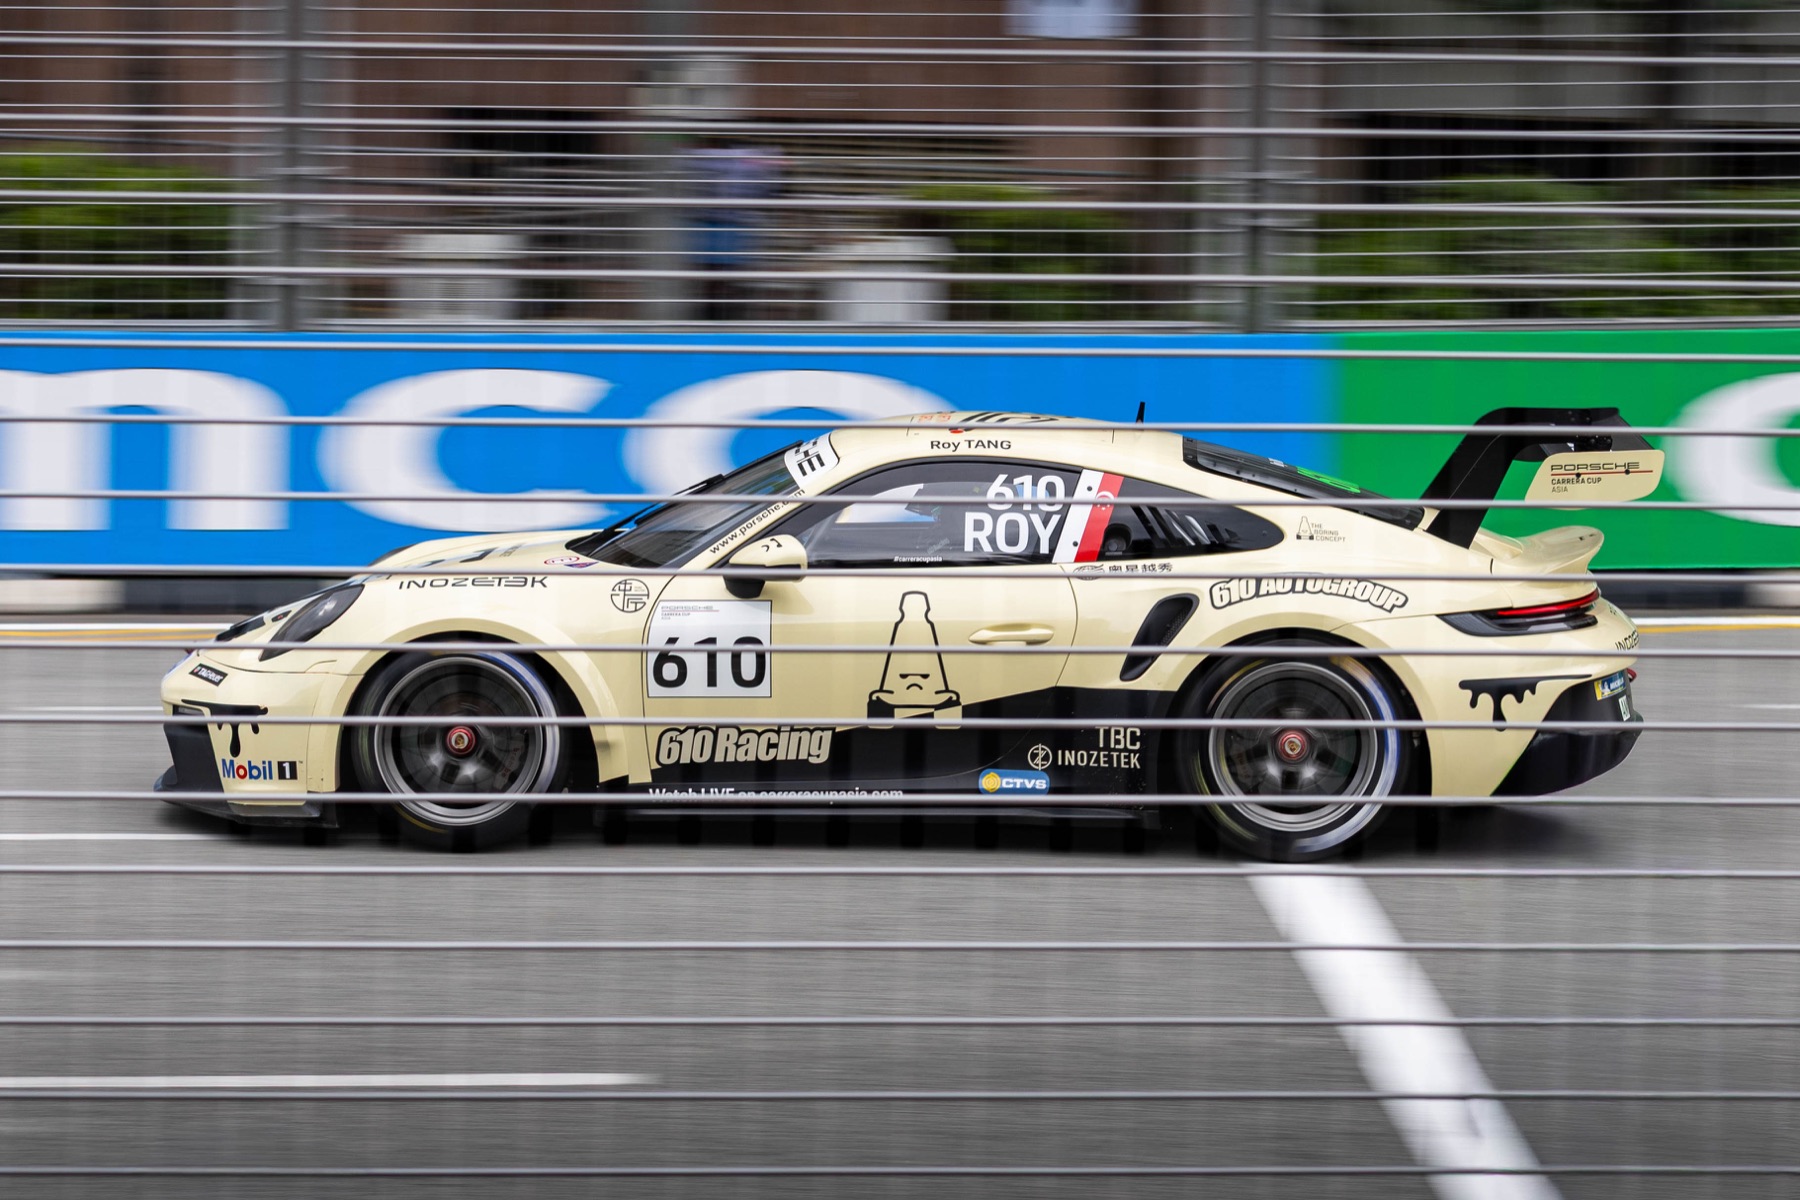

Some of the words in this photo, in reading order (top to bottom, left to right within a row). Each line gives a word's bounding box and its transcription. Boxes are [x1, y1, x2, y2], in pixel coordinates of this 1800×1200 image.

[930, 440, 961, 453] Roy
[964, 439, 1012, 450] TANG
[1550, 461, 1640, 472] PORSCHE
[1551, 477, 1586, 486] CARRERA
[1586, 477, 1602, 485] CUP
[1551, 485, 1569, 494] ASIA
[985, 474, 1066, 512] 610
[964, 512, 1062, 555] ROY
[1315, 535, 1346, 543] CONCEPT
[1209, 577, 1257, 610] 610
[1257, 574, 1408, 613] AUTOGROUP
[652, 636, 767, 688] 610
[656, 727, 715, 765] 610
[713, 725, 834, 764] Racing
[1095, 726, 1142, 750] TBC
[221, 758, 273, 780] Mobil
[1057, 749, 1141, 770] INOZETEK
[1001, 777, 1047, 790] CTVS
